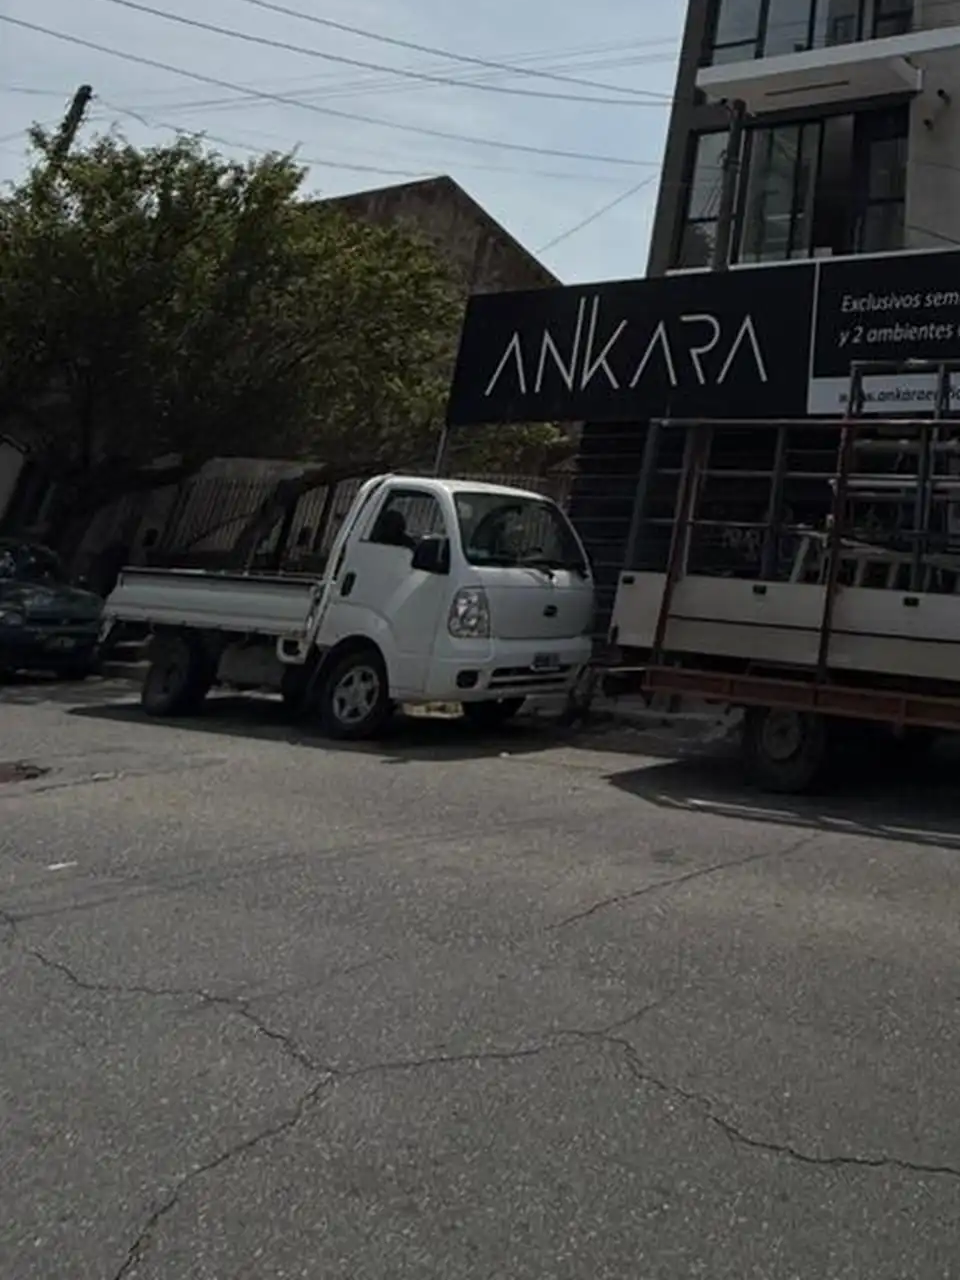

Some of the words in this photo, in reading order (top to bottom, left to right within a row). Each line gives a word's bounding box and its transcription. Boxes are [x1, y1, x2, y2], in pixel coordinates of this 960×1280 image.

[841, 292, 920, 312] Exclusivos
[484, 295, 769, 397] ANKARA
[837, 329, 851, 348] y
[851, 326, 864, 344] 2
[866, 321, 954, 344] ambientes
